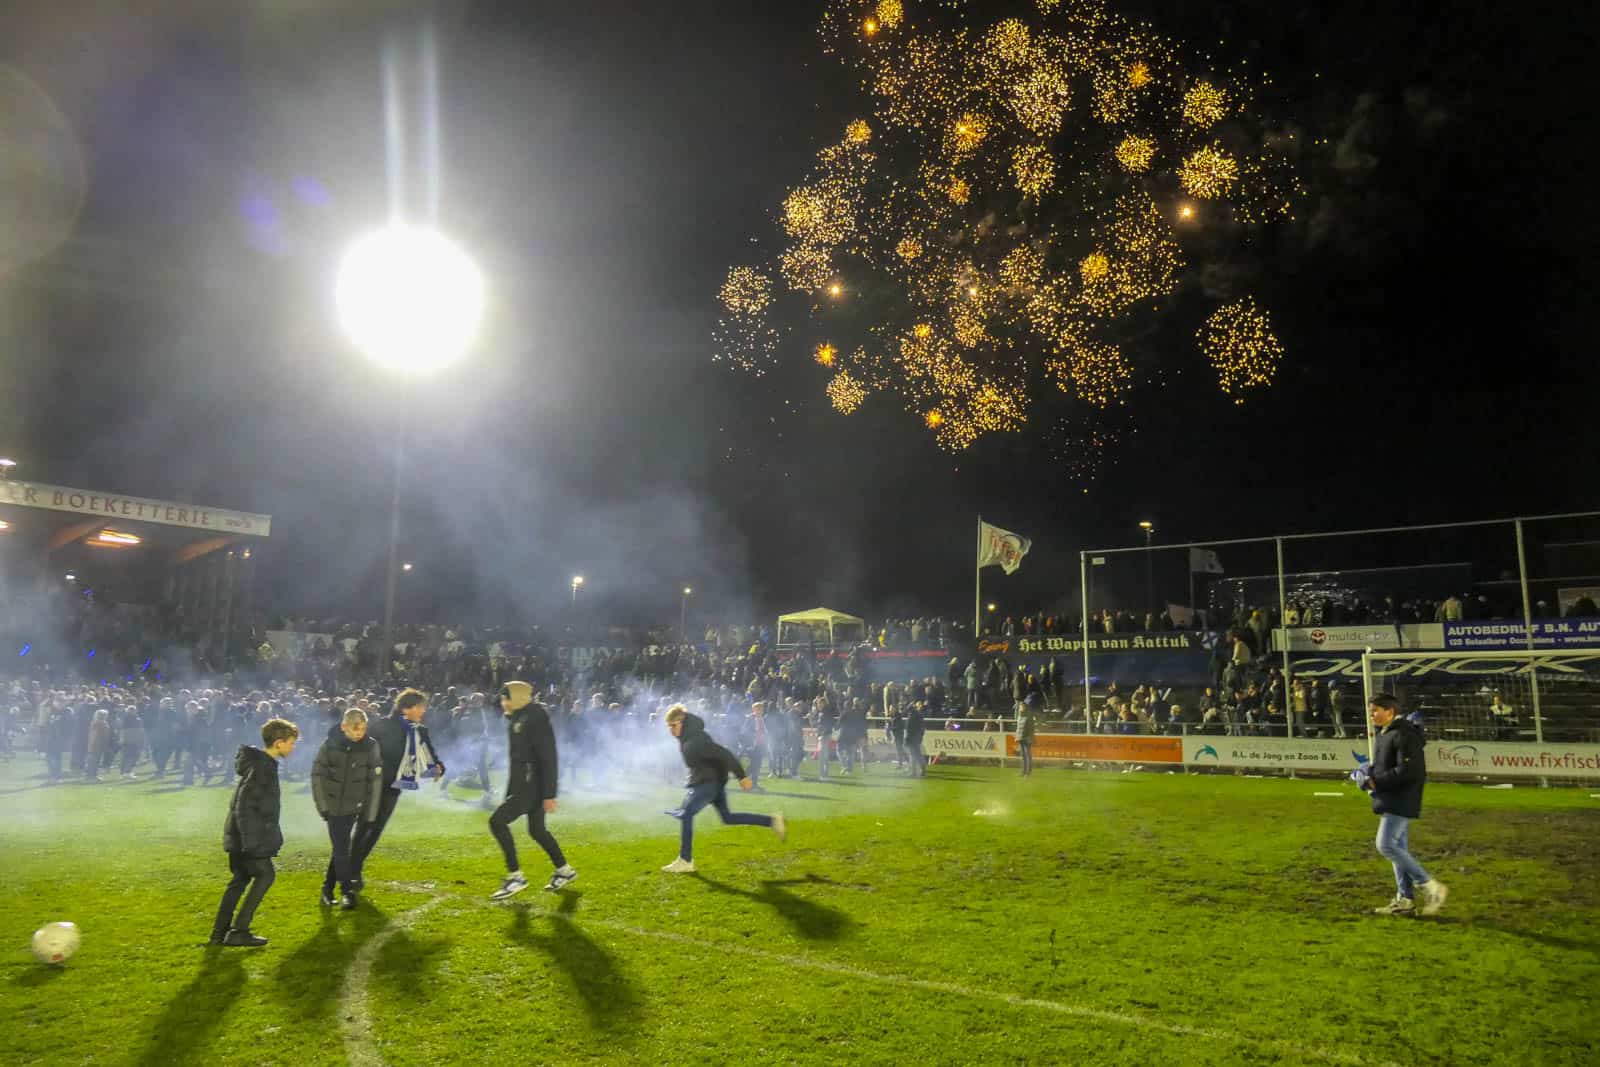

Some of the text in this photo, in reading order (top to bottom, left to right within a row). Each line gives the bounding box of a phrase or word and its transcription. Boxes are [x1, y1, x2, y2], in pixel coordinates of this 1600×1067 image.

[53, 489, 209, 527] BOEKETTERIE
[1544, 623, 1574, 633] B.N.
[1018, 638, 1042, 653] Het
[1047, 637, 1097, 651] Wapen
[1101, 638, 1129, 649] van
[934, 738, 983, 751] PASMAN
[1263, 751, 1283, 761] Jong
[1297, 752, 1319, 761] Zoon
[1321, 752, 1339, 761] B.V.
[1453, 752, 1480, 768] fisch
